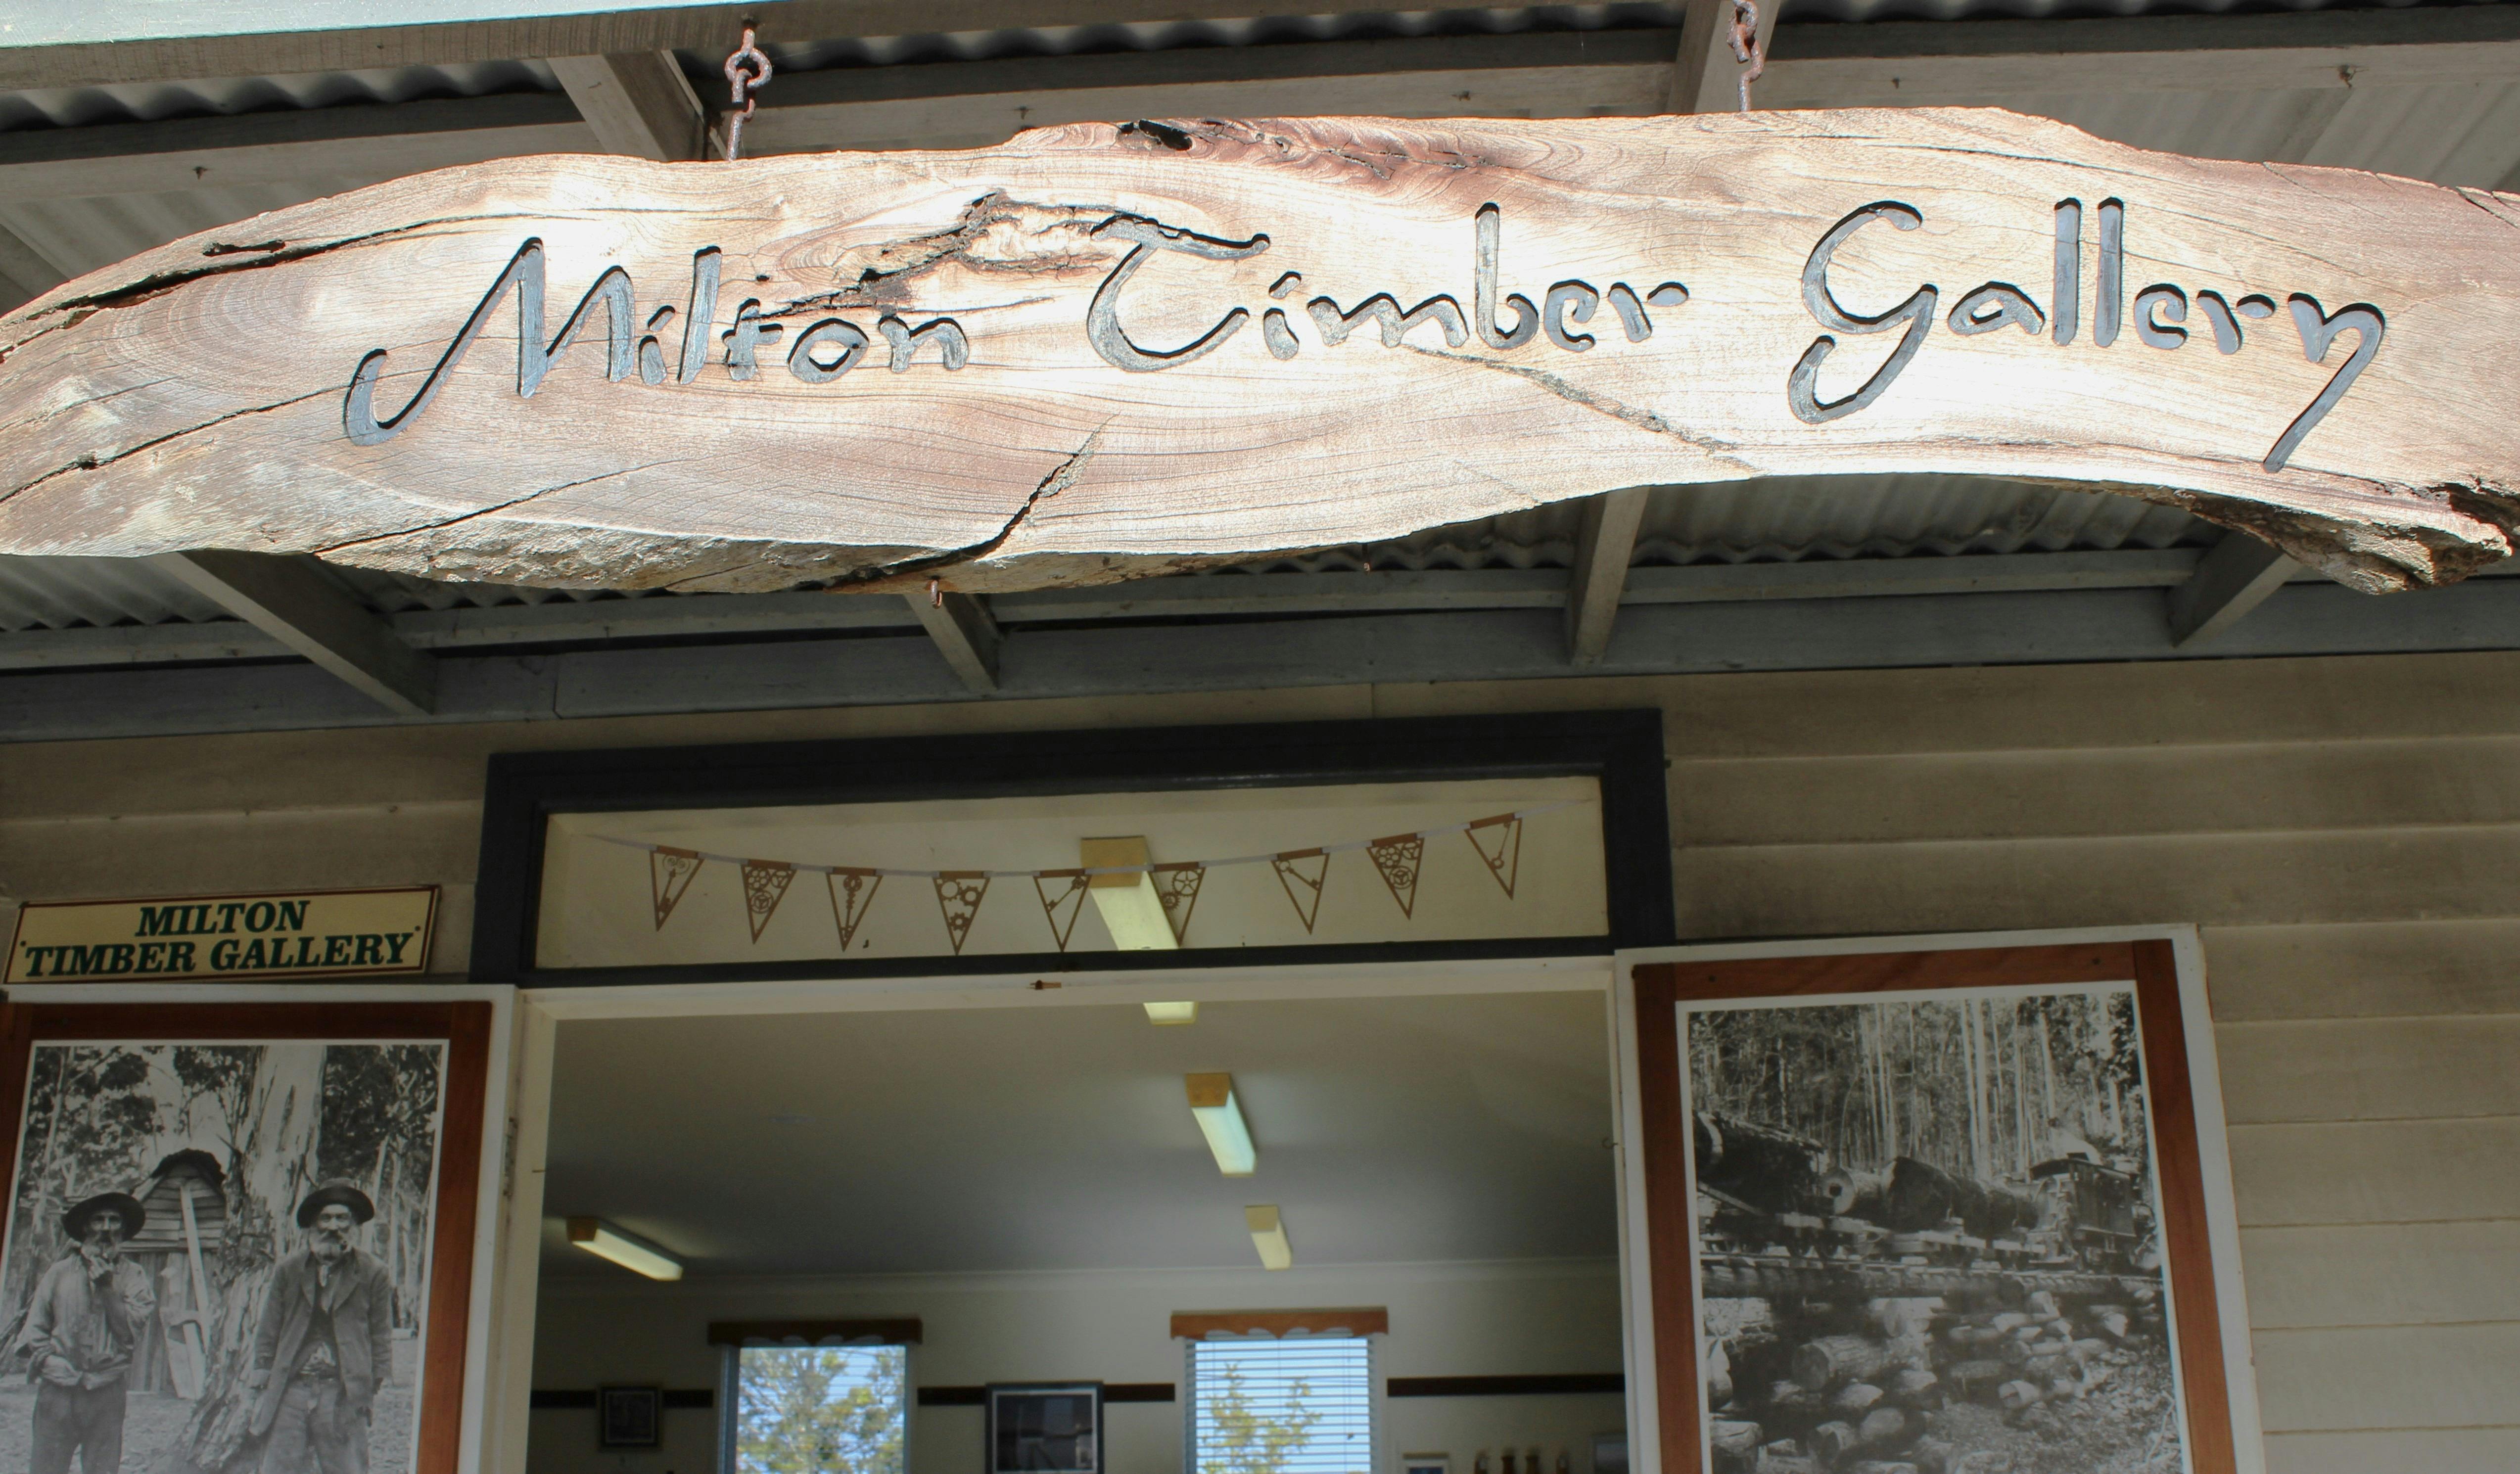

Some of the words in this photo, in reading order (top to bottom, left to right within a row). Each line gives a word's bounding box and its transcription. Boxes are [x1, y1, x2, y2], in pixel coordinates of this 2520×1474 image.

[343, 237, 969, 446] Milton
[1087, 203, 1689, 372] Timber
[1788, 197, 2385, 473] Gallery
[135, 900, 310, 937] MILTON
[25, 941, 196, 977] TIMBER
[210, 932, 414, 971] GALLERY
